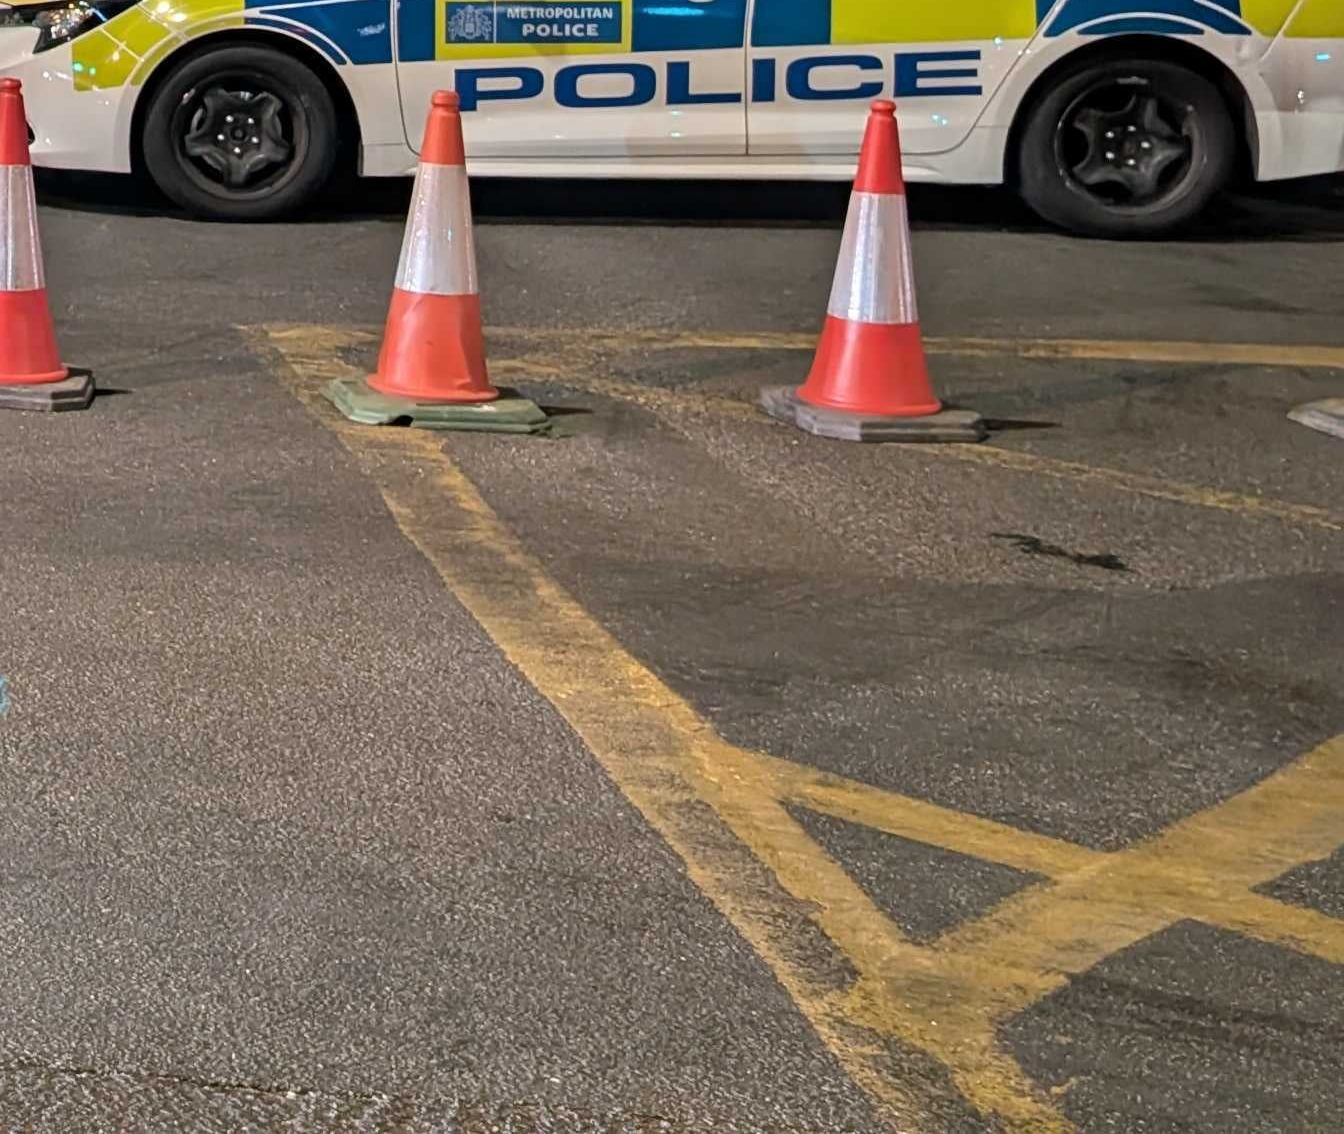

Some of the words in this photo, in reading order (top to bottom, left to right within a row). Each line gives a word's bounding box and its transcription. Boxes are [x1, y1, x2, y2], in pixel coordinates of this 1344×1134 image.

[506, 7, 613, 19] METROPOLITAN
[522, 24, 599, 37] POLICE
[454, 50, 983, 112] POLICE
